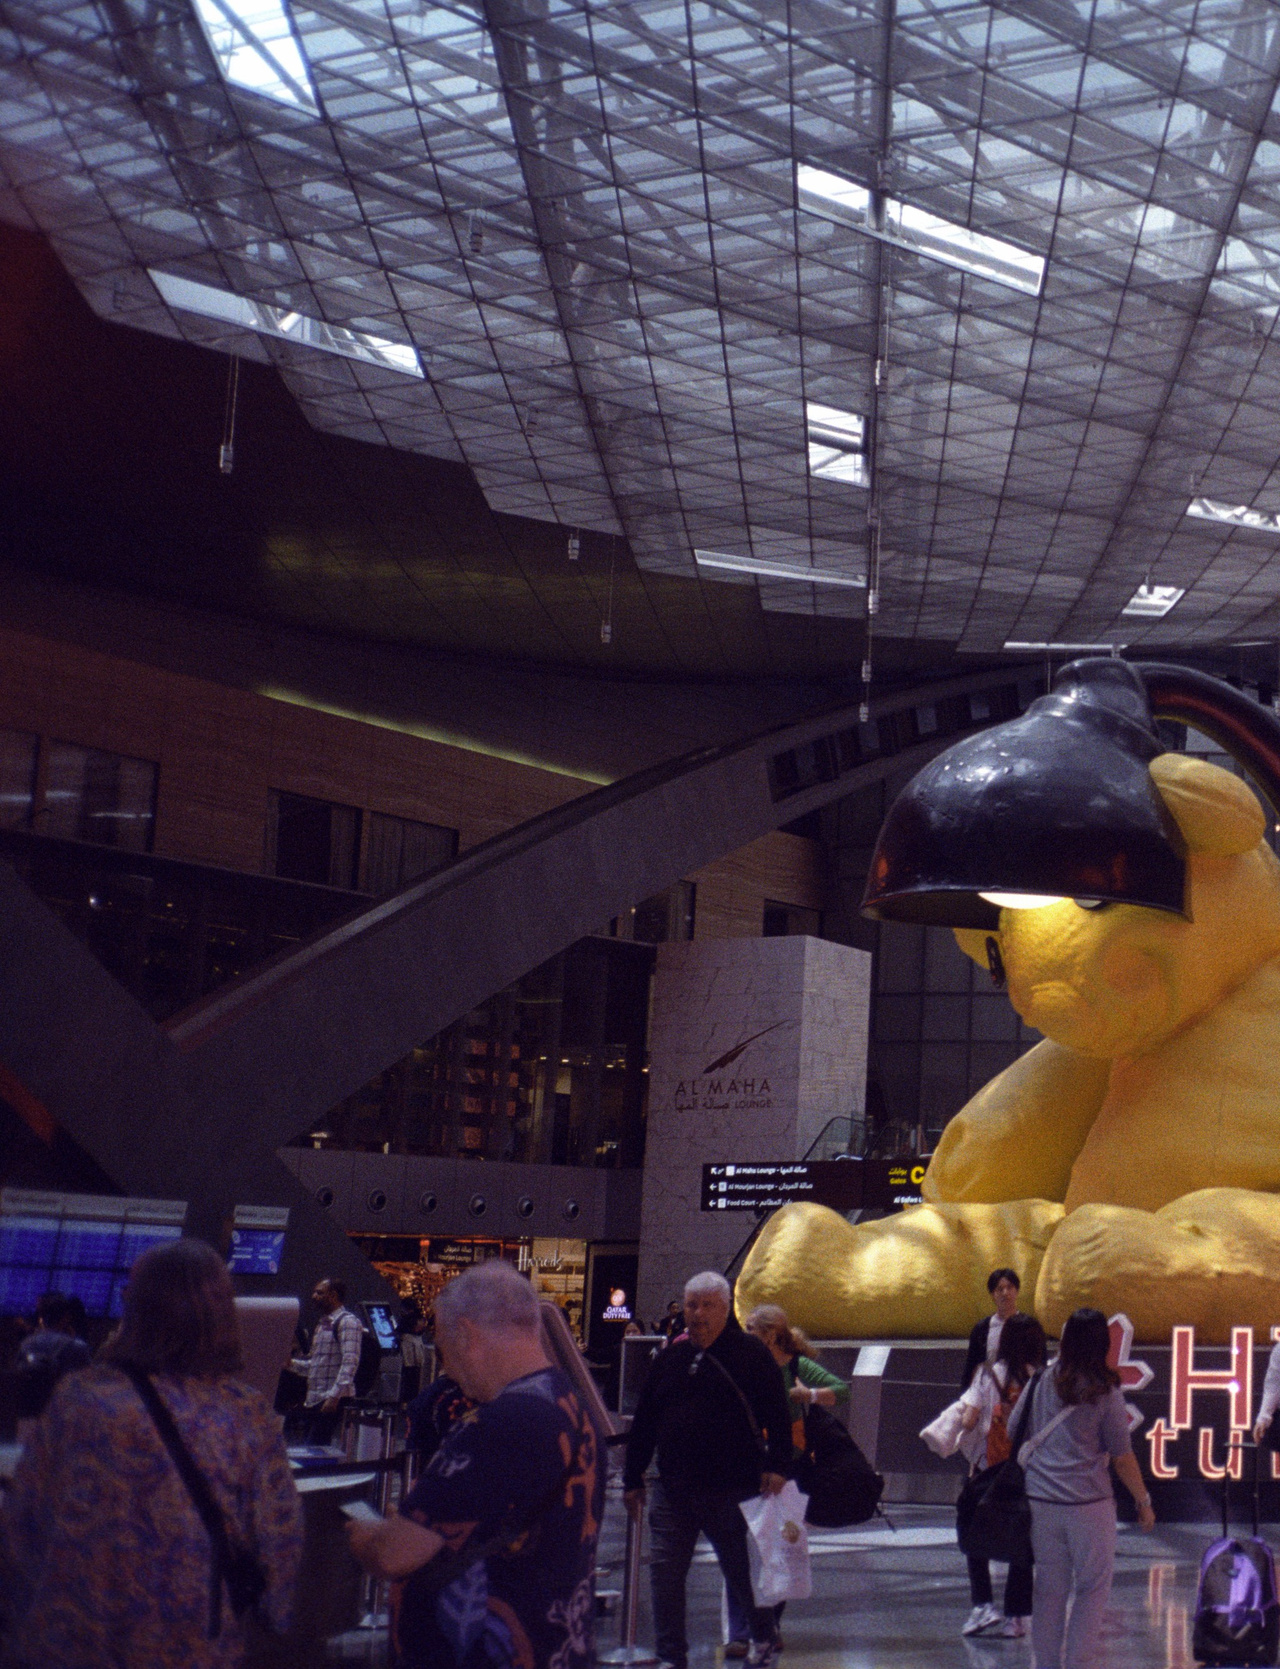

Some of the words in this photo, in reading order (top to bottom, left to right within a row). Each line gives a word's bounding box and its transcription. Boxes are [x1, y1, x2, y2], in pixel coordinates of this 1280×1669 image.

[675, 1080, 698, 1096] AL
[707, 1079, 771, 1094] MAHA
[734, 1099, 773, 1109] LOUNGE
[514, 1245, 562, 1271] Harrods
[606, 1306, 628, 1314] QATAR
